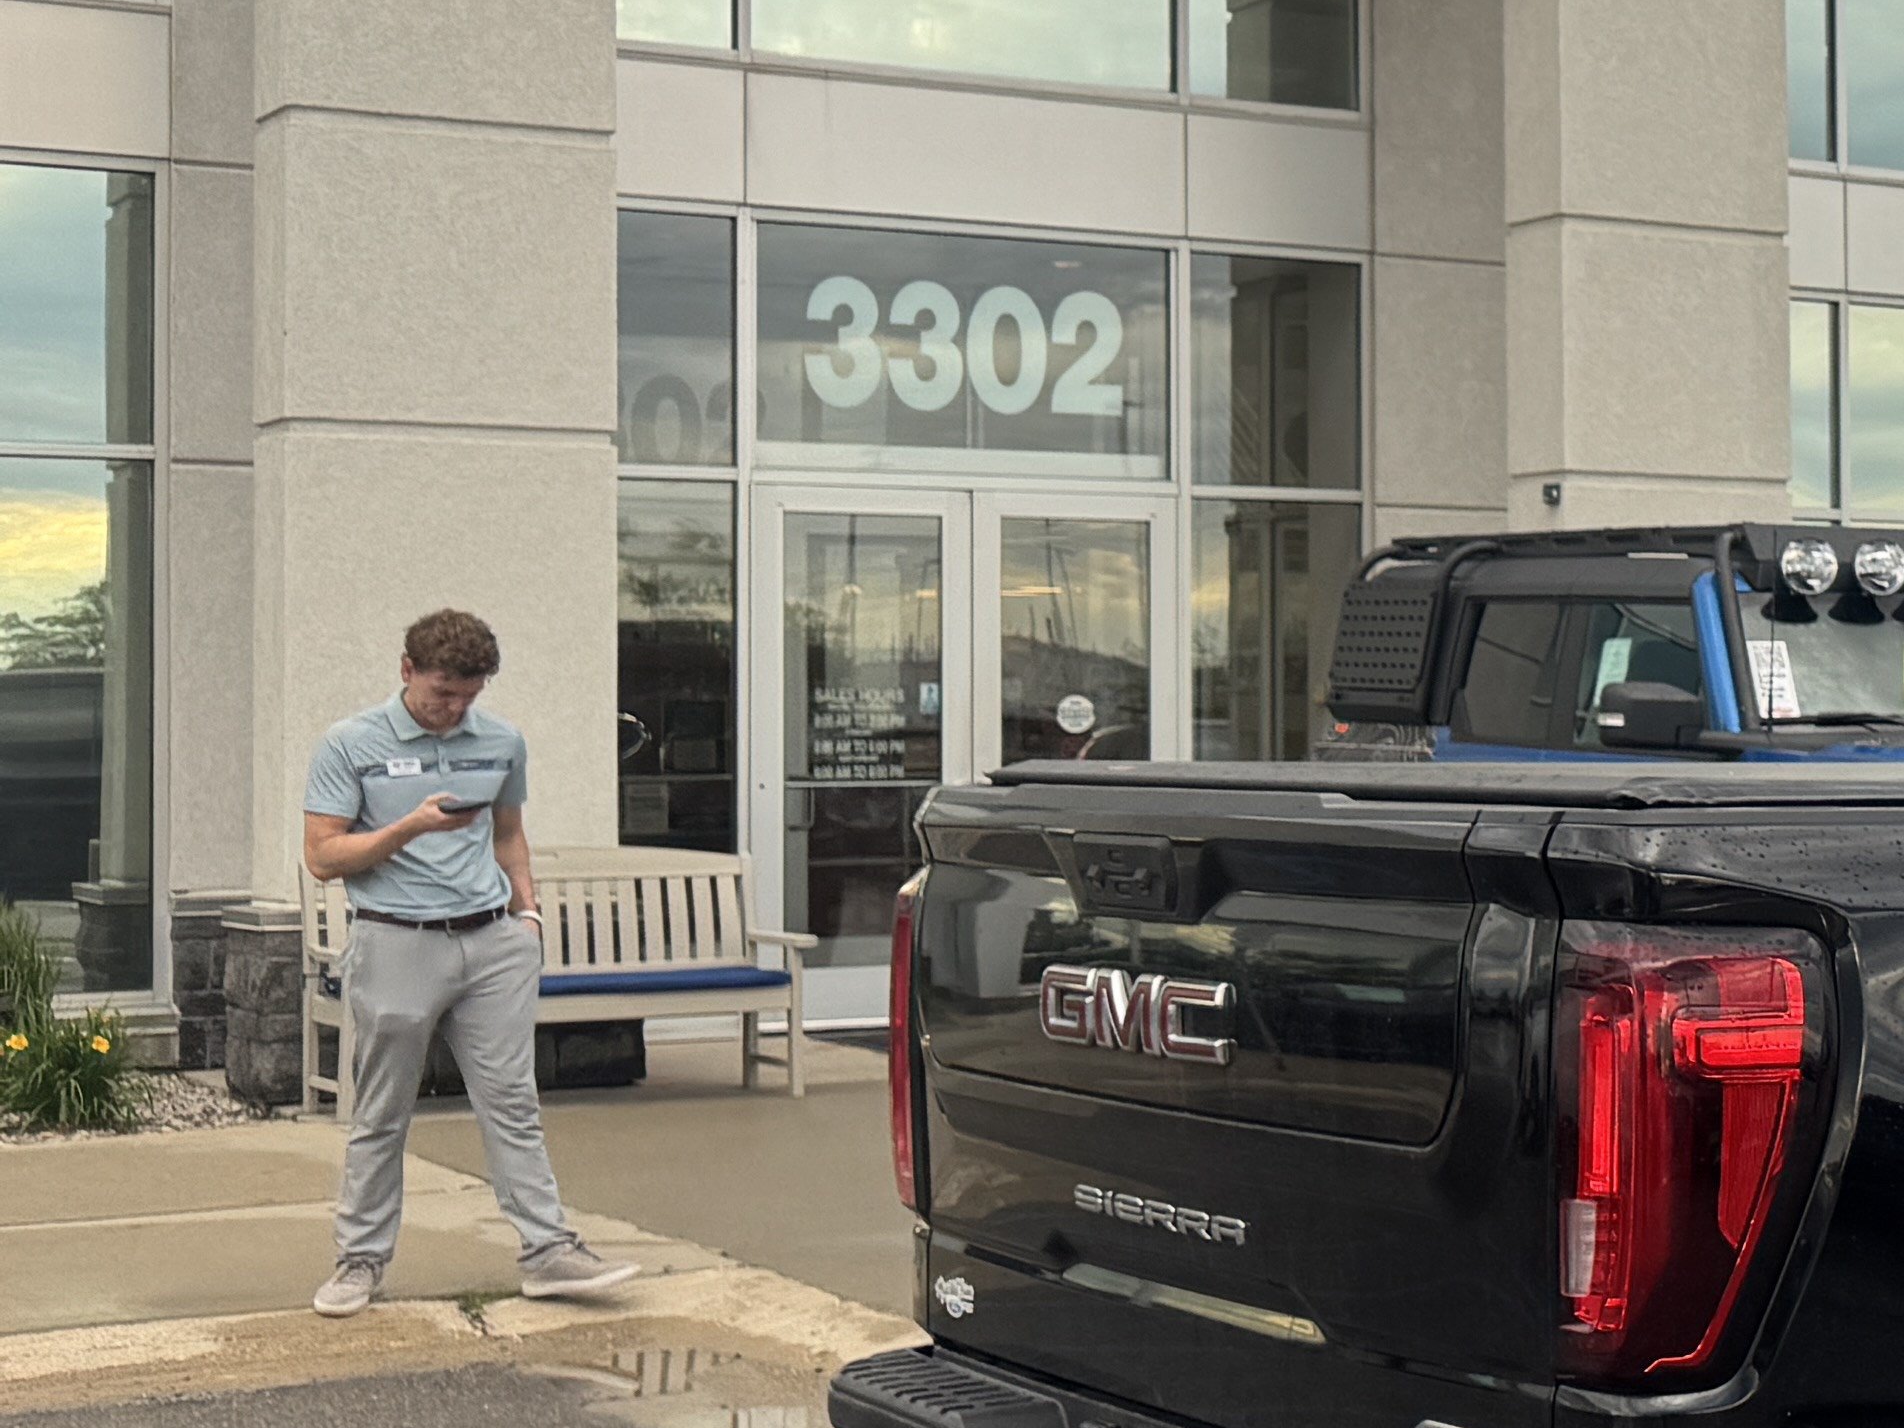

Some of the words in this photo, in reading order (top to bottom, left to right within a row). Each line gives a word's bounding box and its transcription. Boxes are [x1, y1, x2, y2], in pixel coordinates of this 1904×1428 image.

[803, 275, 1124, 417] 3302
[1038, 962, 1237, 1067] GMC
[1073, 1182, 1251, 1248] SIERRA
